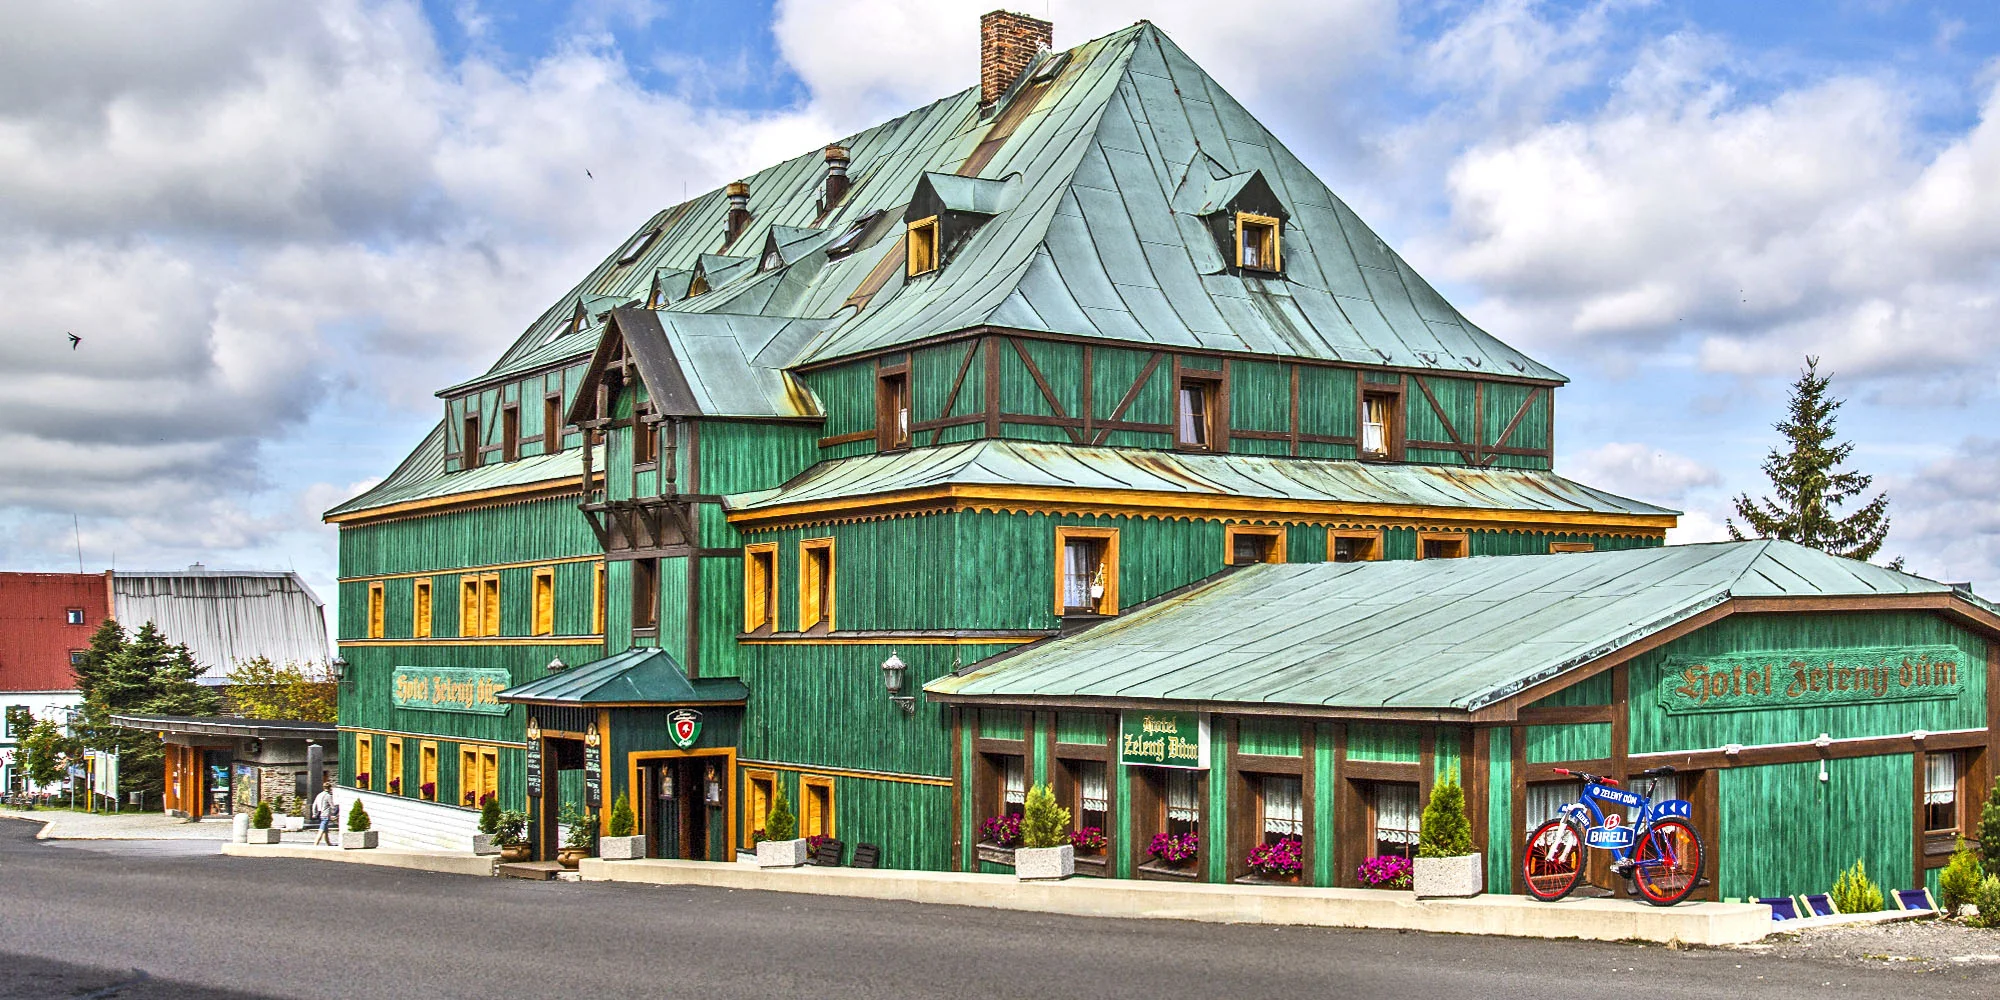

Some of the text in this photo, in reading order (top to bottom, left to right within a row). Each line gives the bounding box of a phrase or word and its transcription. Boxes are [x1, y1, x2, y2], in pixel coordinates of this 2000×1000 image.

[396, 674, 429, 704] Hotel
[432, 676, 474, 709] Zelený
[1675, 654, 1957, 706] Hotel Zelený dům
[1143, 715, 1177, 736] Hotel
[1124, 733, 1199, 762] Zelený Dům
[1600, 788, 1638, 805] ZELENÝ DŮM
[1590, 831, 1628, 843] BIRELL
